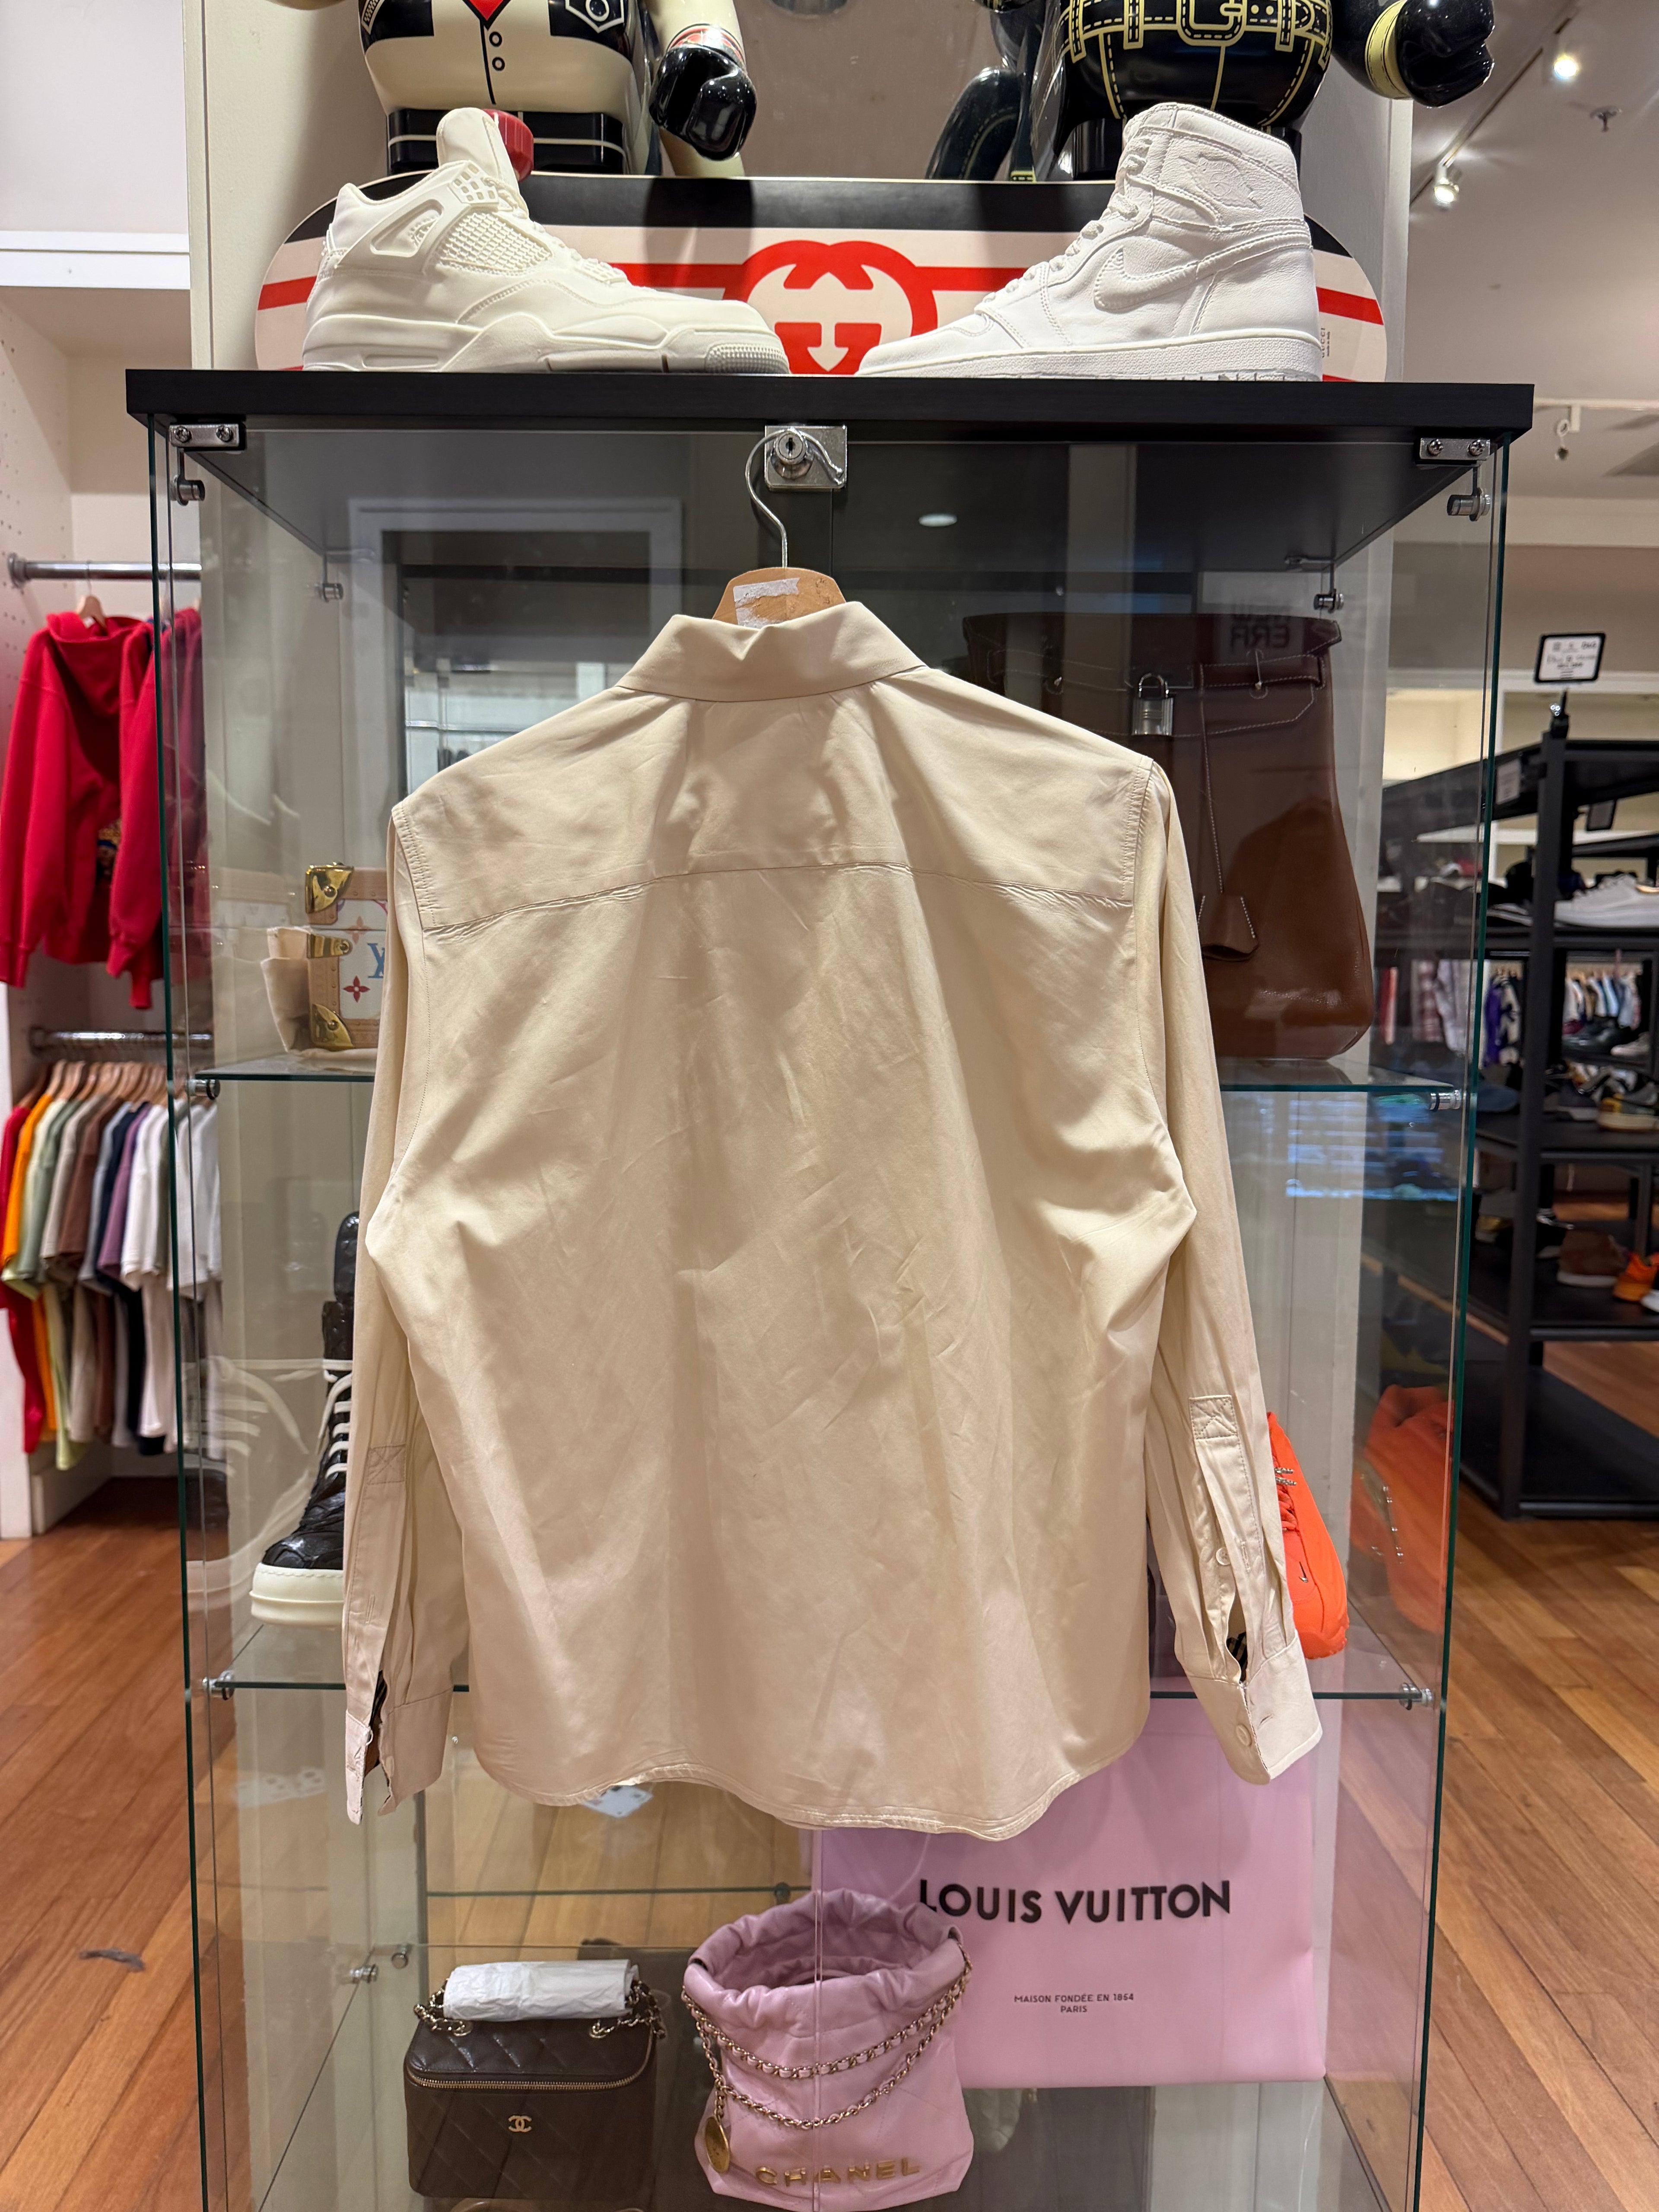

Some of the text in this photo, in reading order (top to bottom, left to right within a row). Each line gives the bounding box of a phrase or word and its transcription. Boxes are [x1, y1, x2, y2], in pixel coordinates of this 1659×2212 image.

[920, 1879, 1230, 1924] LOUIS VUITTON
[1014, 1995, 1051, 2003] MAISON
[1055, 1993, 1093, 2002] FONDÉE
[756, 2157, 920, 2187] CHANEL
